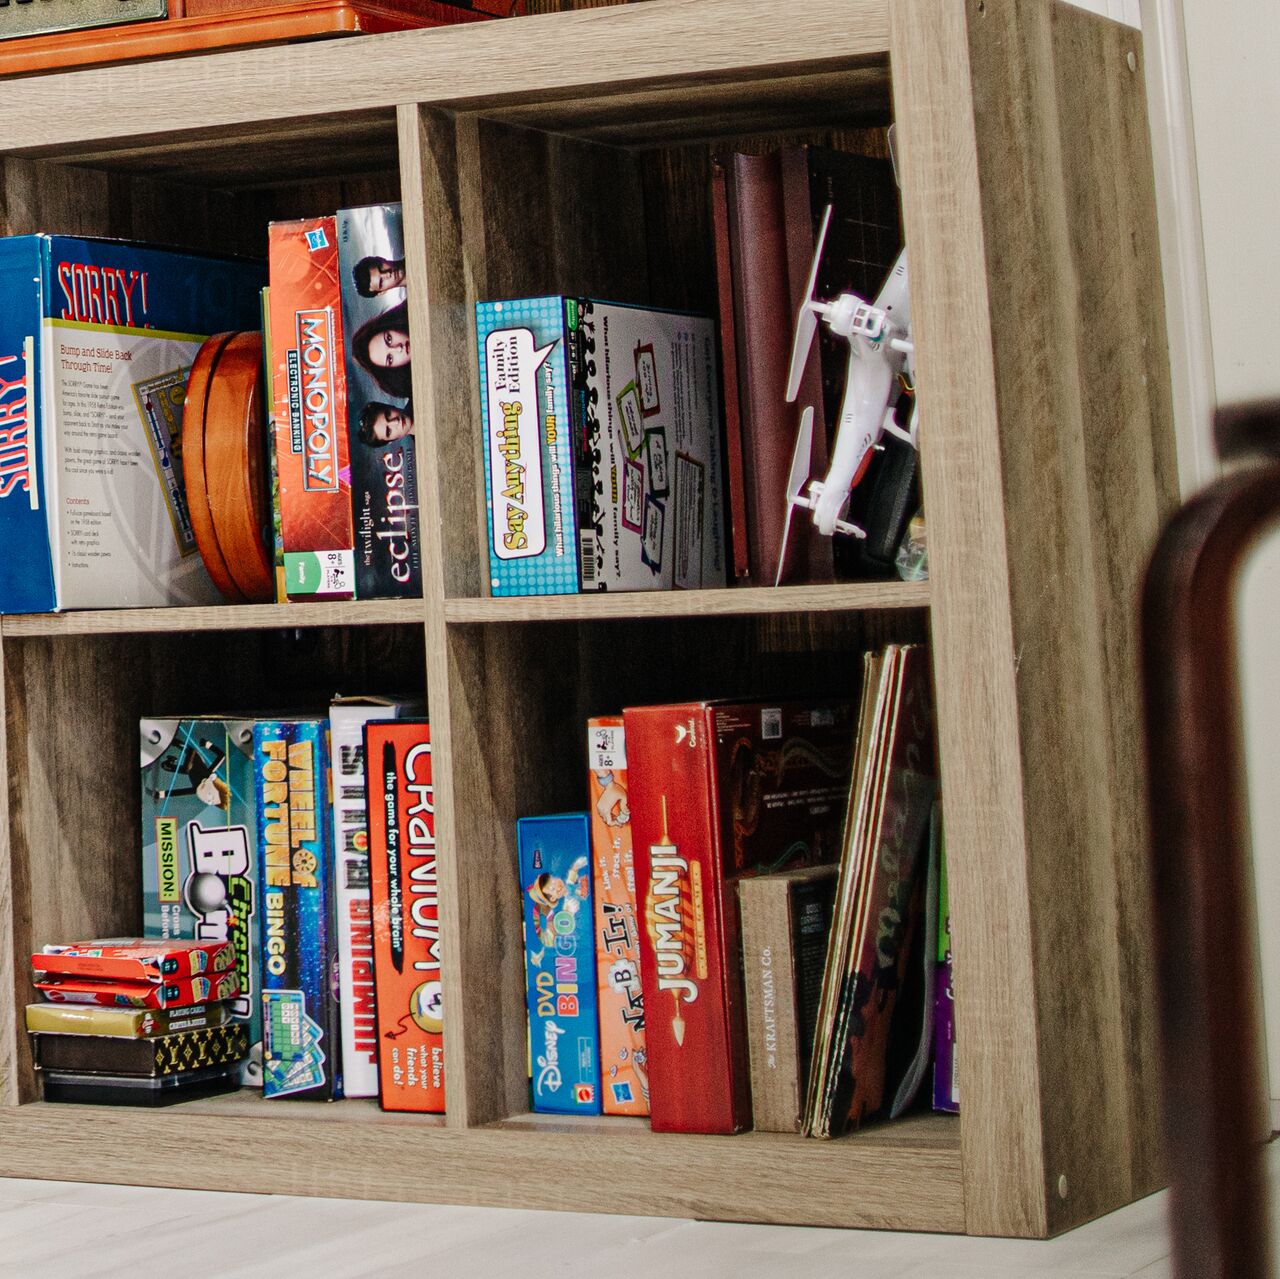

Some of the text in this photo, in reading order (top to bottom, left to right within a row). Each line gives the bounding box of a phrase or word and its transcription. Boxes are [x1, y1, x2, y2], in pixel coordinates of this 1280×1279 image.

[58, 261, 148, 329] SORRY!
[61, 344, 132, 361] Bump and Slide Back
[61, 359, 112, 374] Through Time!
[492, 339, 508, 391] Family
[507, 336, 520, 394] Edition
[289, 352, 302, 451] ELECTRONIC BANKING
[301, 319, 332, 484] MONOPOLY
[496, 401, 528, 550] Say Anything
[543, 362, 564, 557] What hilarious things will YOUR family say?
[359, 508, 374, 555] twilight
[376, 453, 419, 582] eclipse
[327, 553, 337, 564] 8+
[288, 740, 316, 848] WHEEL
[604, 756, 613, 766] 8+
[262, 740, 290, 887] FORTUNE
[161, 823, 175, 897] MISSION:
[385, 772, 402, 949] the game for your whole brain
[161, 905, 170, 939] Before
[266, 892, 286, 976] BINGO
[650, 845, 698, 1002] JUMANJI
[761, 945, 771, 966] Co.
[348, 898, 376, 1064] JUMPING
[537, 972, 555, 1017] DVD
[553, 910, 579, 1017] BINGO
[762, 969, 777, 1052] KRAFTSMAN
[393, 1066, 404, 1085] do!
[407, 1047, 419, 1086] friends
[418, 1044, 429, 1089] what your
[431, 1048, 443, 1088] believe
[537, 1020, 565, 1096] Disney
